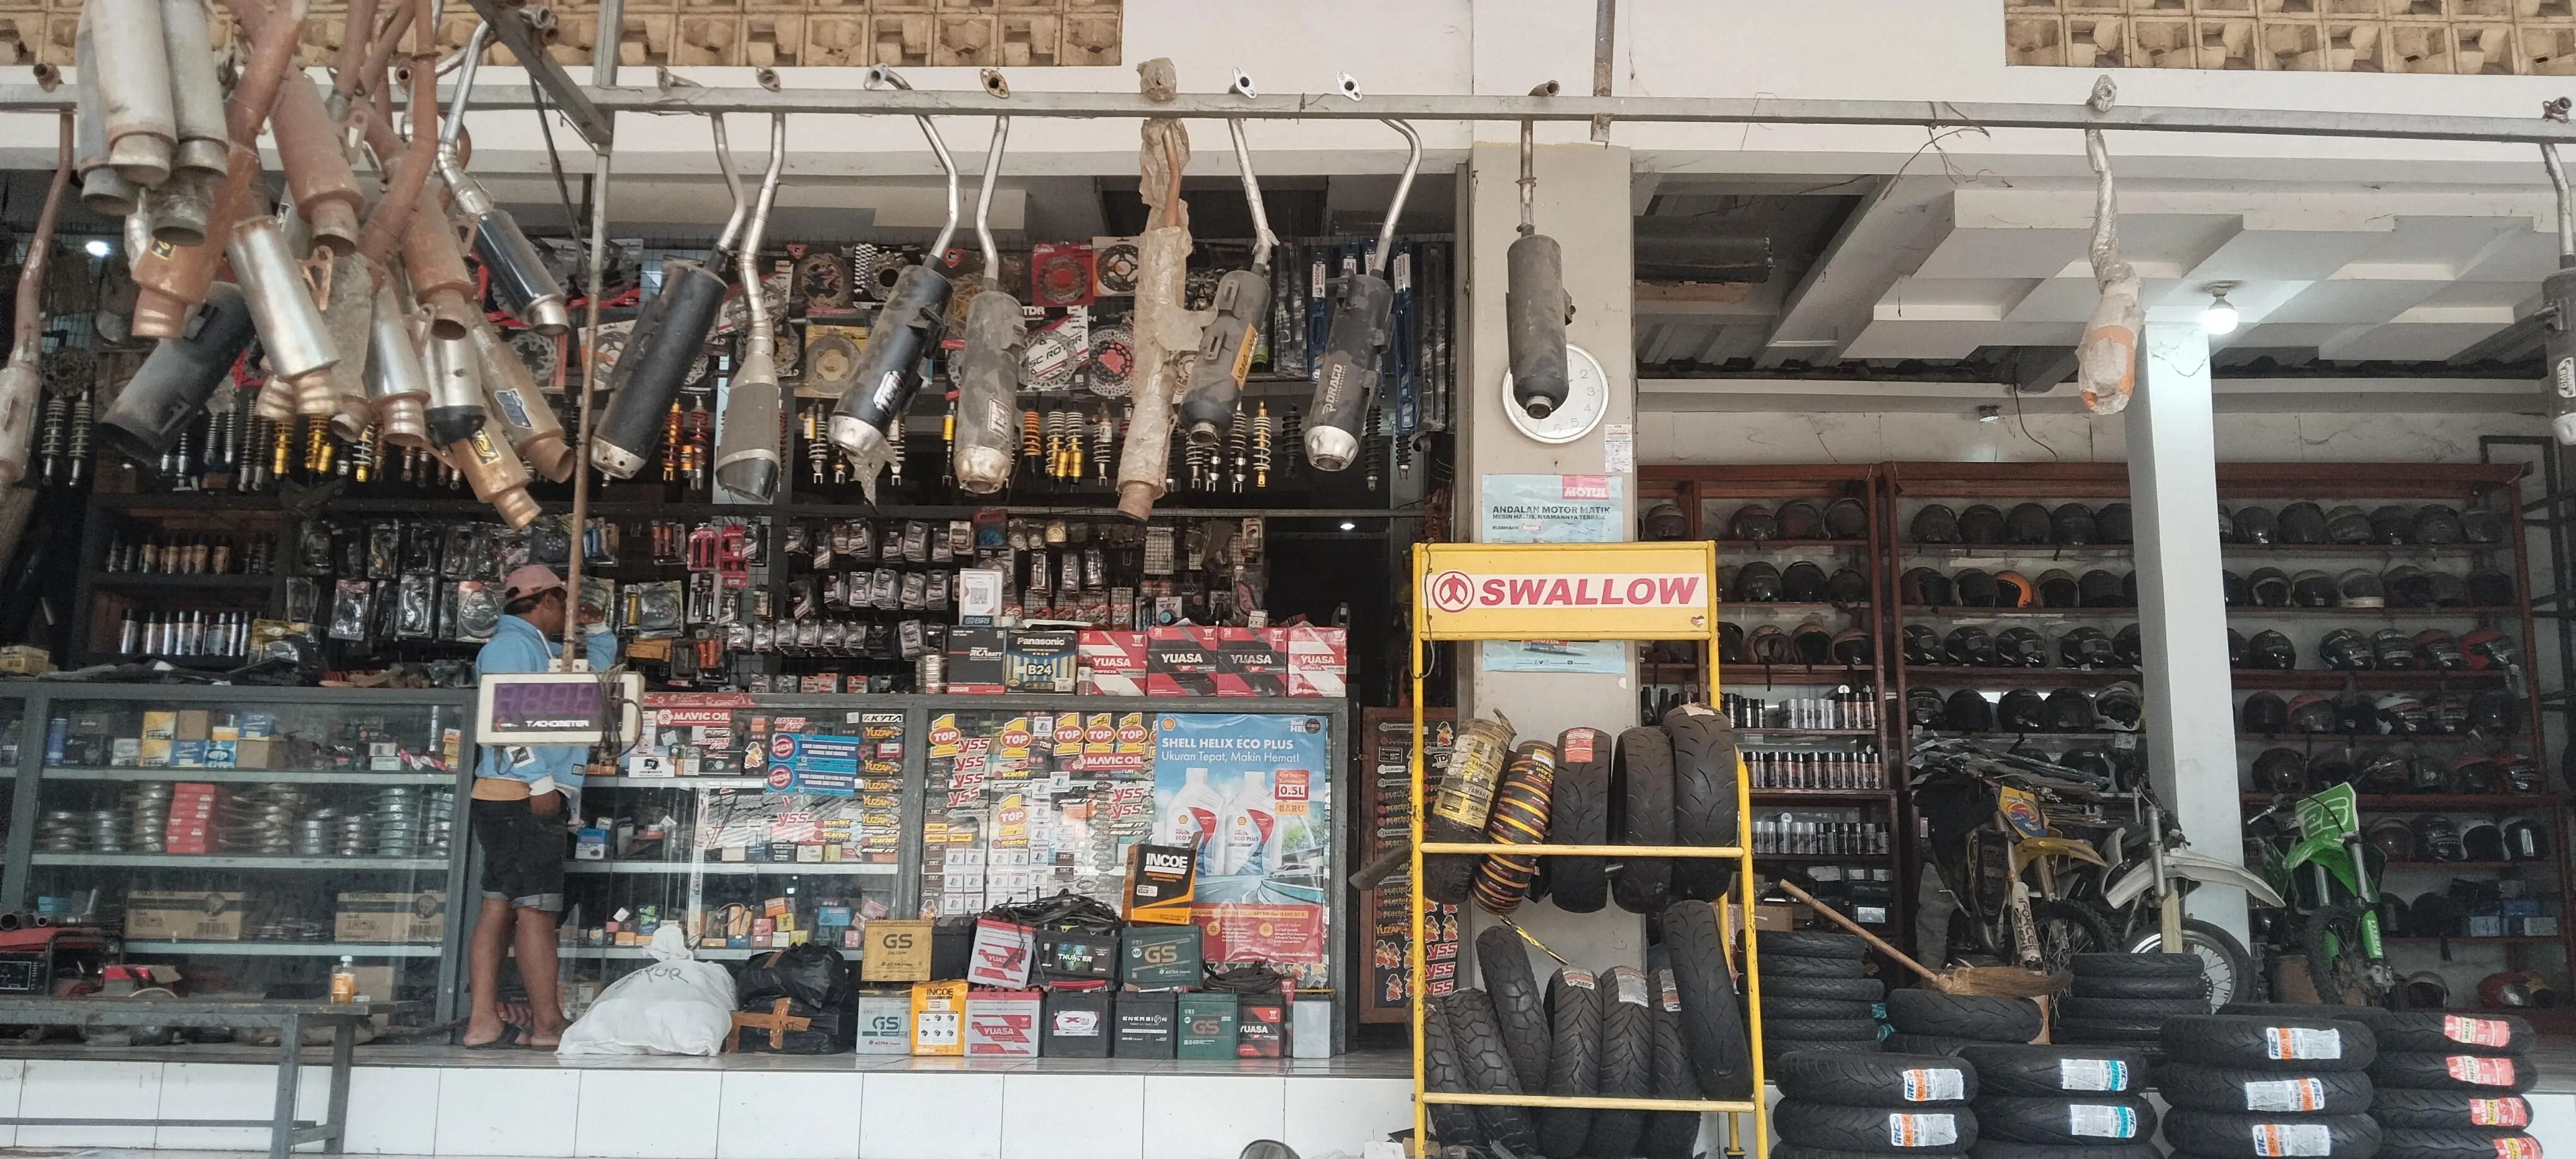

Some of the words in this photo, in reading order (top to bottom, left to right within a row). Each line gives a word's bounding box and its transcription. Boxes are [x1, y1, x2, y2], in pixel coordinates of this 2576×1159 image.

[1564, 487, 1607, 497] MOTUL
[1479, 576, 1700, 606] SWALLOW
[1017, 637, 1066, 646] Panasonic
[1093, 658, 1131, 667] YUASA
[1161, 653, 1203, 663] YUASA
[1230, 654, 1272, 664] YUASA
[1300, 655, 1335, 664] YUASA
[1028, 665, 1052, 675] B24
[674, 712, 711, 720] MAVIC
[712, 712, 730, 720] OIL
[933, 732, 957, 742] TOP
[1005, 735, 1028, 745] TOP
[1057, 730, 1081, 740] TOP
[1088, 730, 1112, 740] TOP
[1120, 730, 1144, 740] TOP
[772, 743, 793, 752] FSCM
[1162, 737, 1196, 749] SHELL
[1199, 738, 1234, 749] HELIX
[1236, 739, 1261, 749] ECO
[1264, 739, 1294, 750] PLUS
[1087, 756, 1124, 764] MAVIC
[1124, 756, 1143, 764] OIL
[1161, 751, 1196, 761] Ukuran
[1199, 752, 1228, 764] Tepat,
[1231, 751, 1261, 762] Makin
[769, 773, 790, 783] FSCM
[1280, 785, 1304, 796] 0.5L
[1279, 804, 1305, 813] BARU
[1000, 812, 1024, 822] TOP
[1146, 853, 1188, 869] INCOE
[883, 934, 913, 949] GS
[1144, 946, 1178, 963] GS
[984, 1027, 1014, 1035] YUASA
[1192, 1020, 1220, 1035] GS
